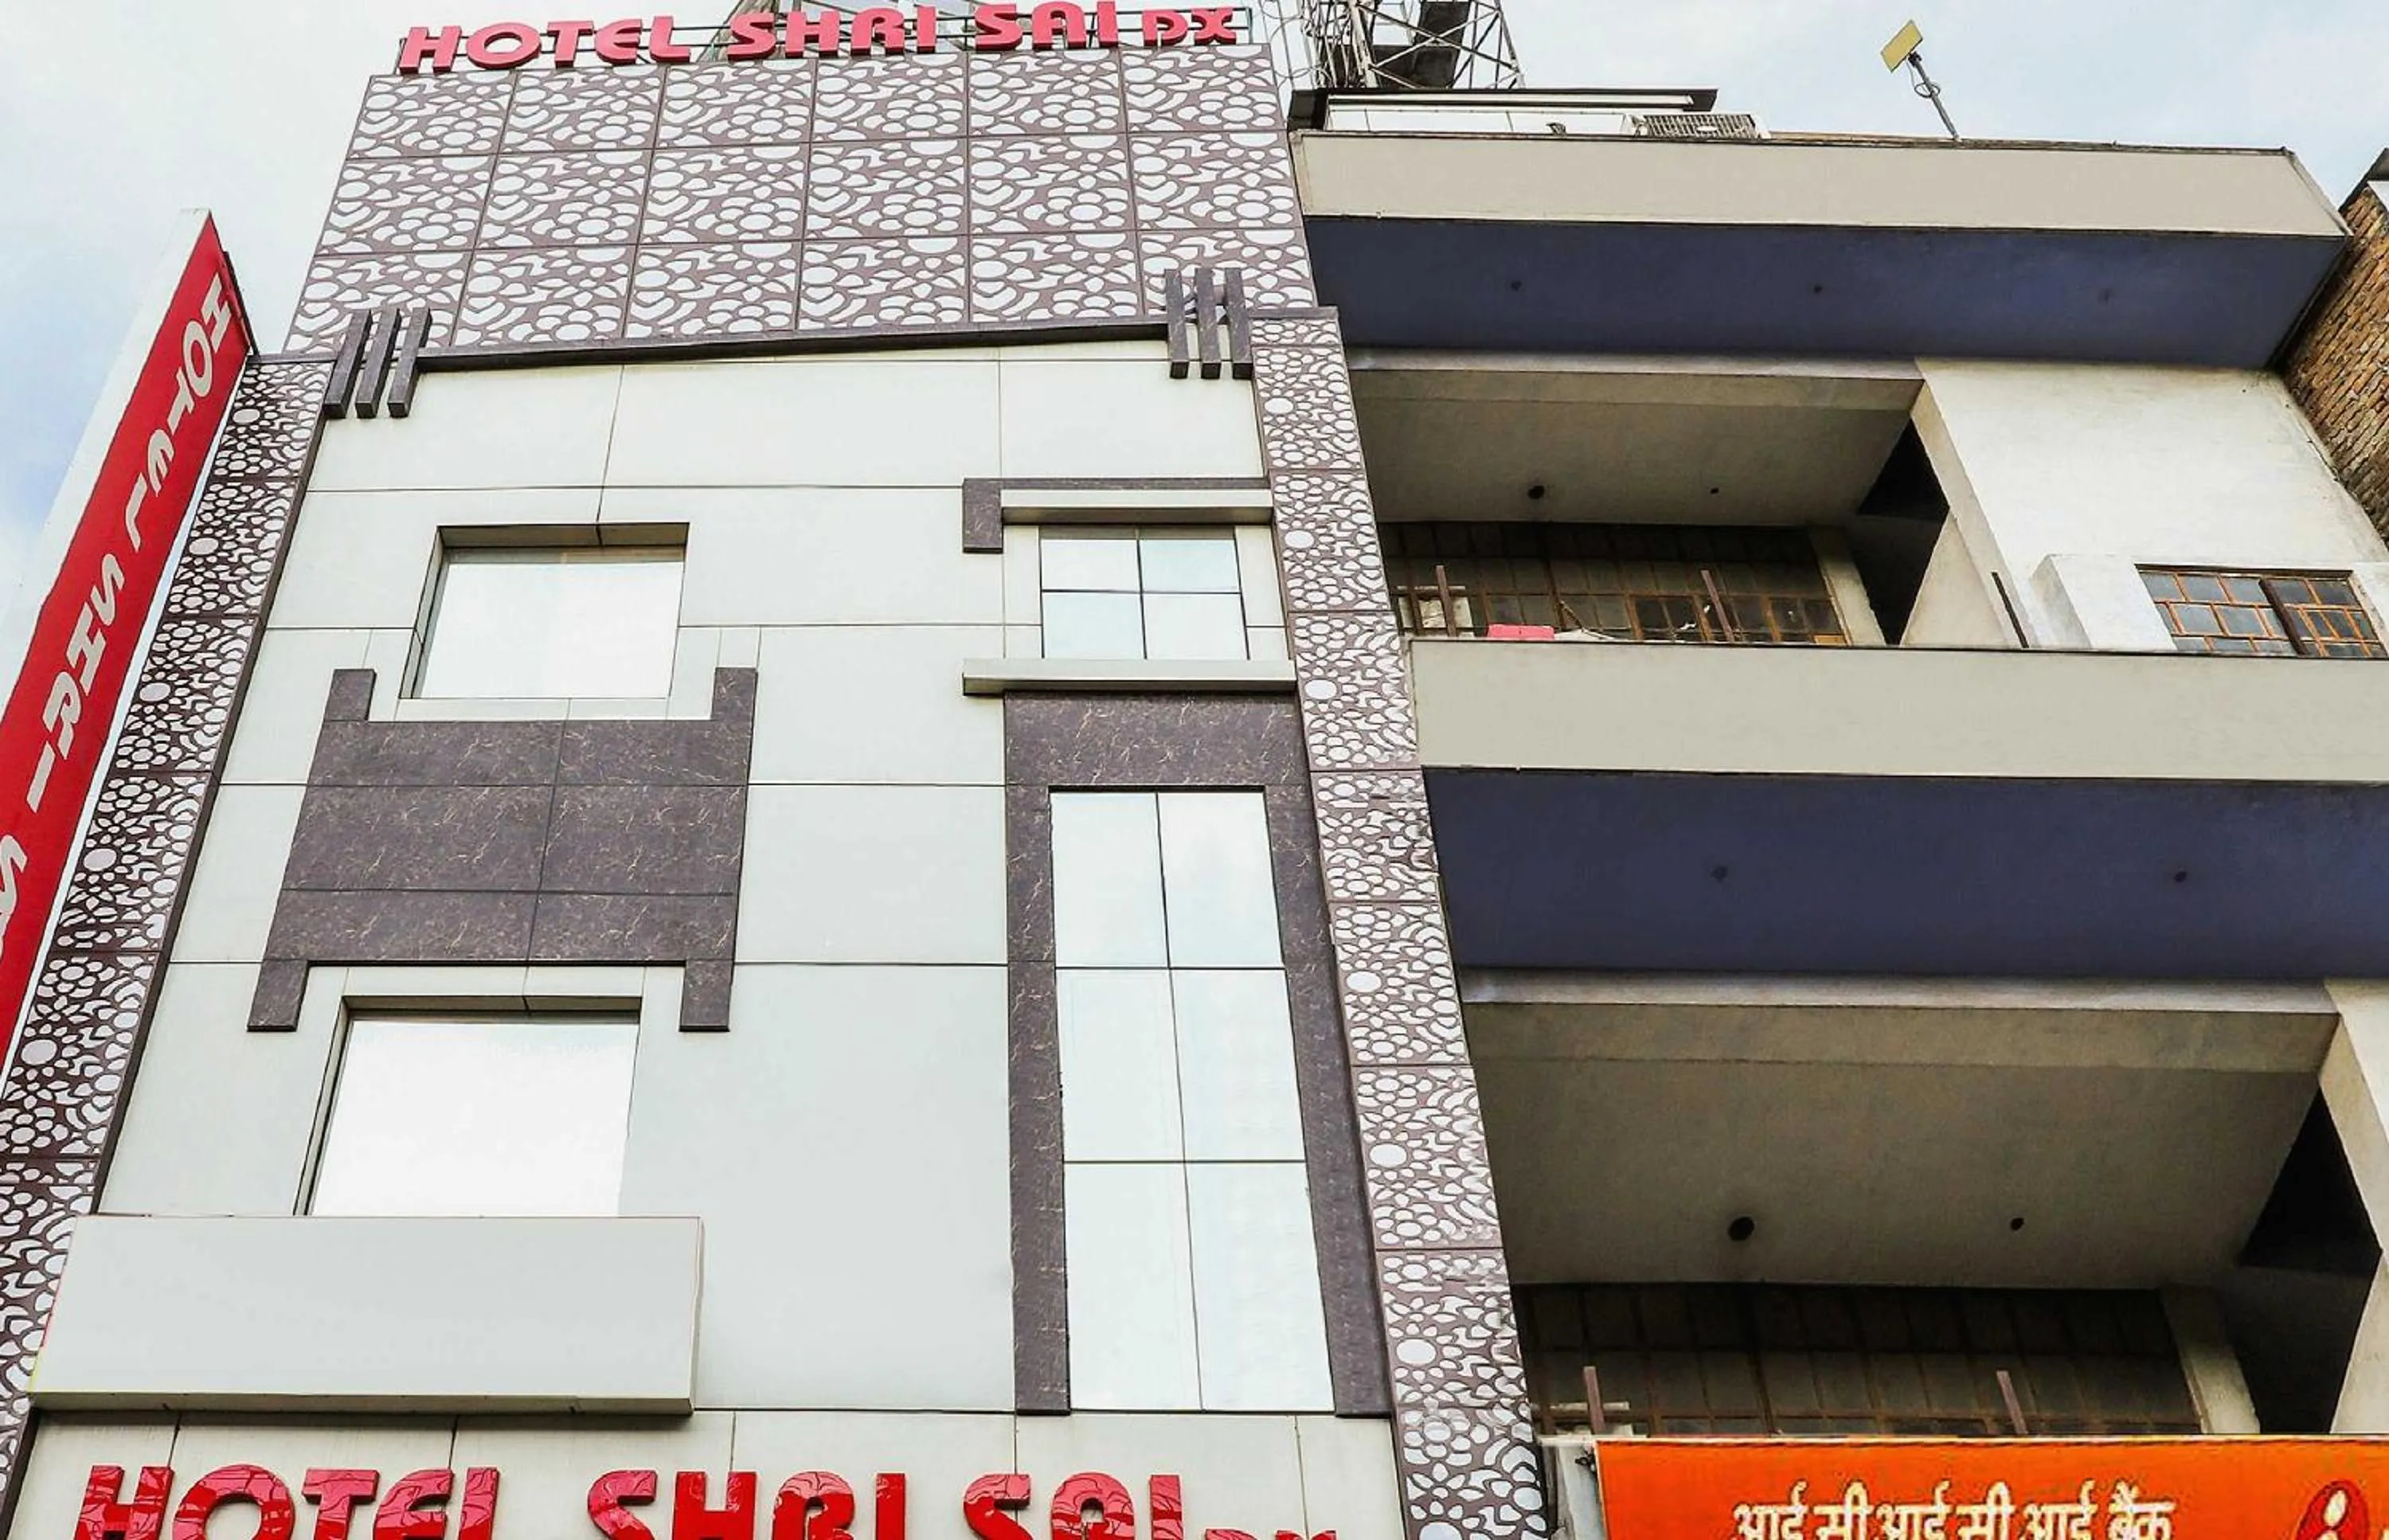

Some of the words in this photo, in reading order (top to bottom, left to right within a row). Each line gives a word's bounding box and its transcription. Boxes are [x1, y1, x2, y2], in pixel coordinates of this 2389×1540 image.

[400, 15, 691, 74] HOTEL
[726, 4, 937, 61] SHRI
[974, 1, 1119, 51] SAI
[1143, 7, 1237, 46] DX
[125, 273, 231, 551] HOTEL
[26, 553, 124, 814] SHRI
[587, 1470, 905, 1540] SHRI
[963, 1470, 1185, 1540] SAI
